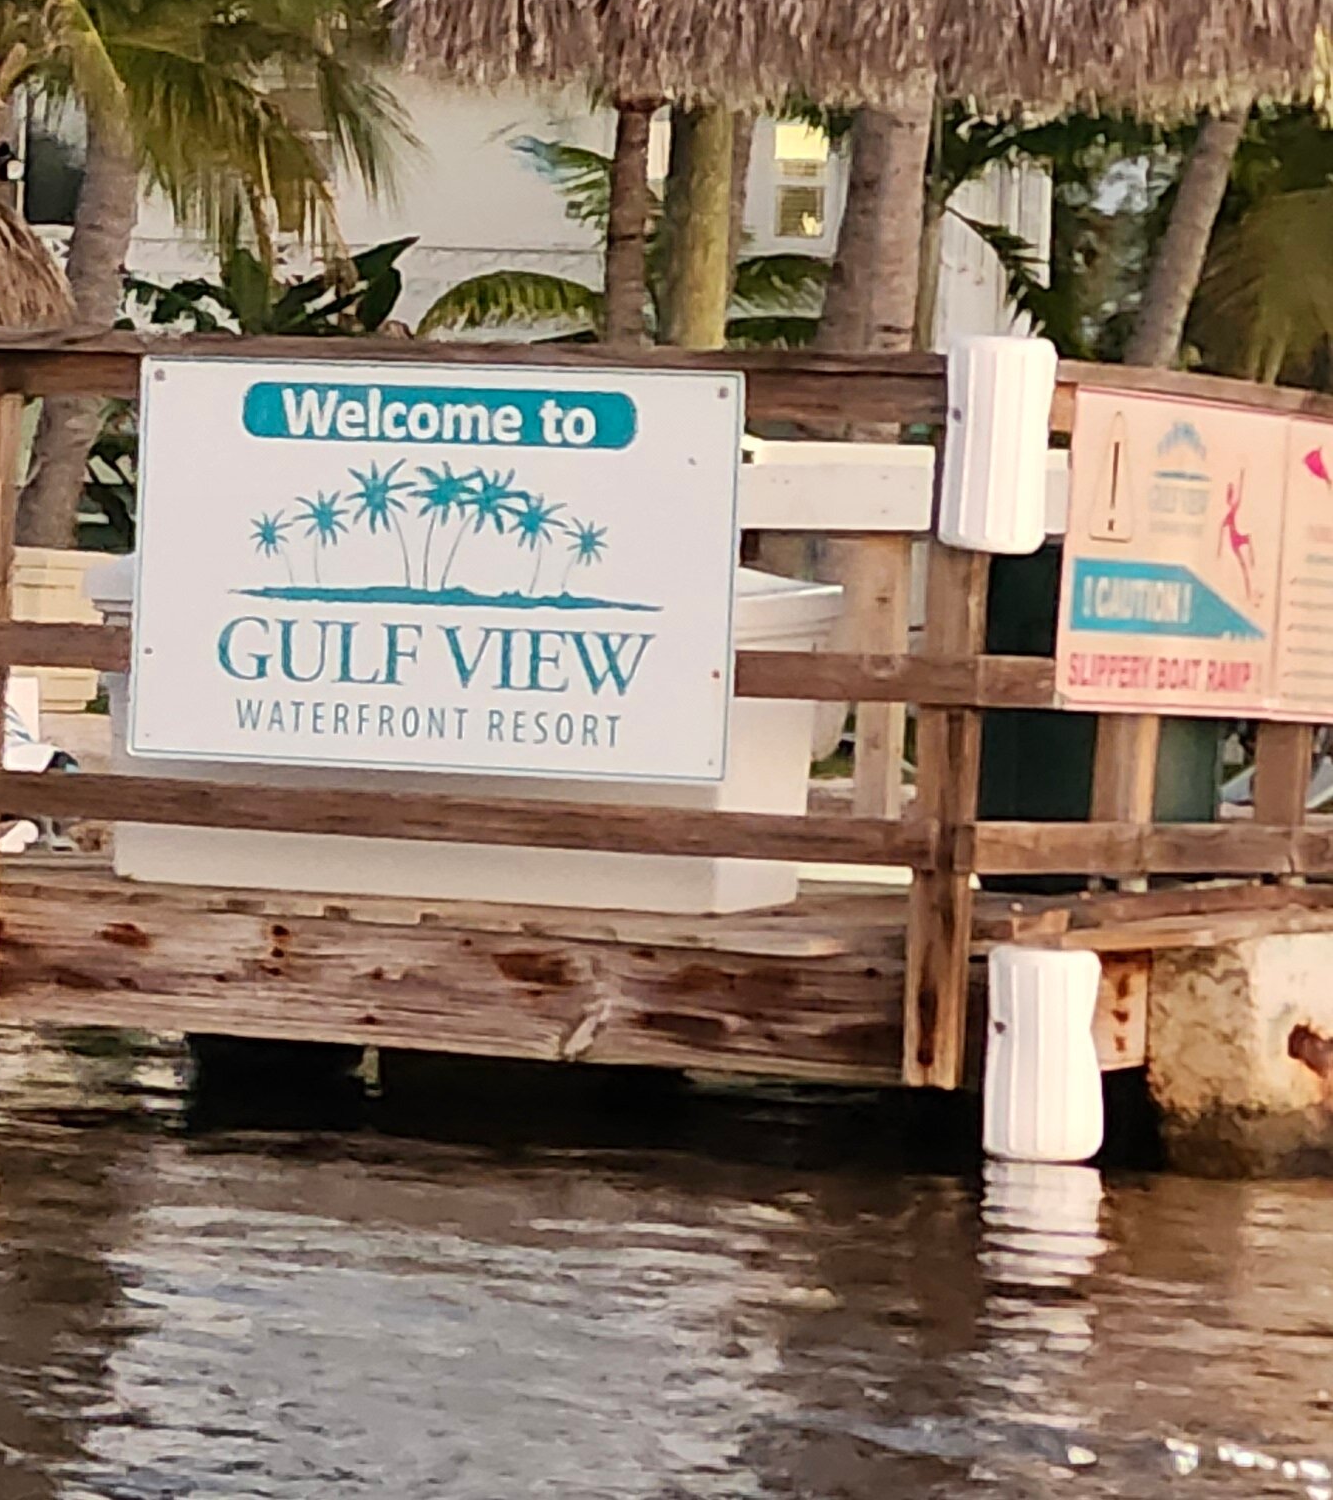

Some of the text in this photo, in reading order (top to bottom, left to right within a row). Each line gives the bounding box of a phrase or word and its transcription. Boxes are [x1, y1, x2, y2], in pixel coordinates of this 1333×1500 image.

[282, 387, 597, 445] Welcome to
[217, 615, 657, 696] GULF VIEW
[1156, 657, 1202, 691] BOAT
[235, 698, 623, 749] WATERFRONT RESORT
